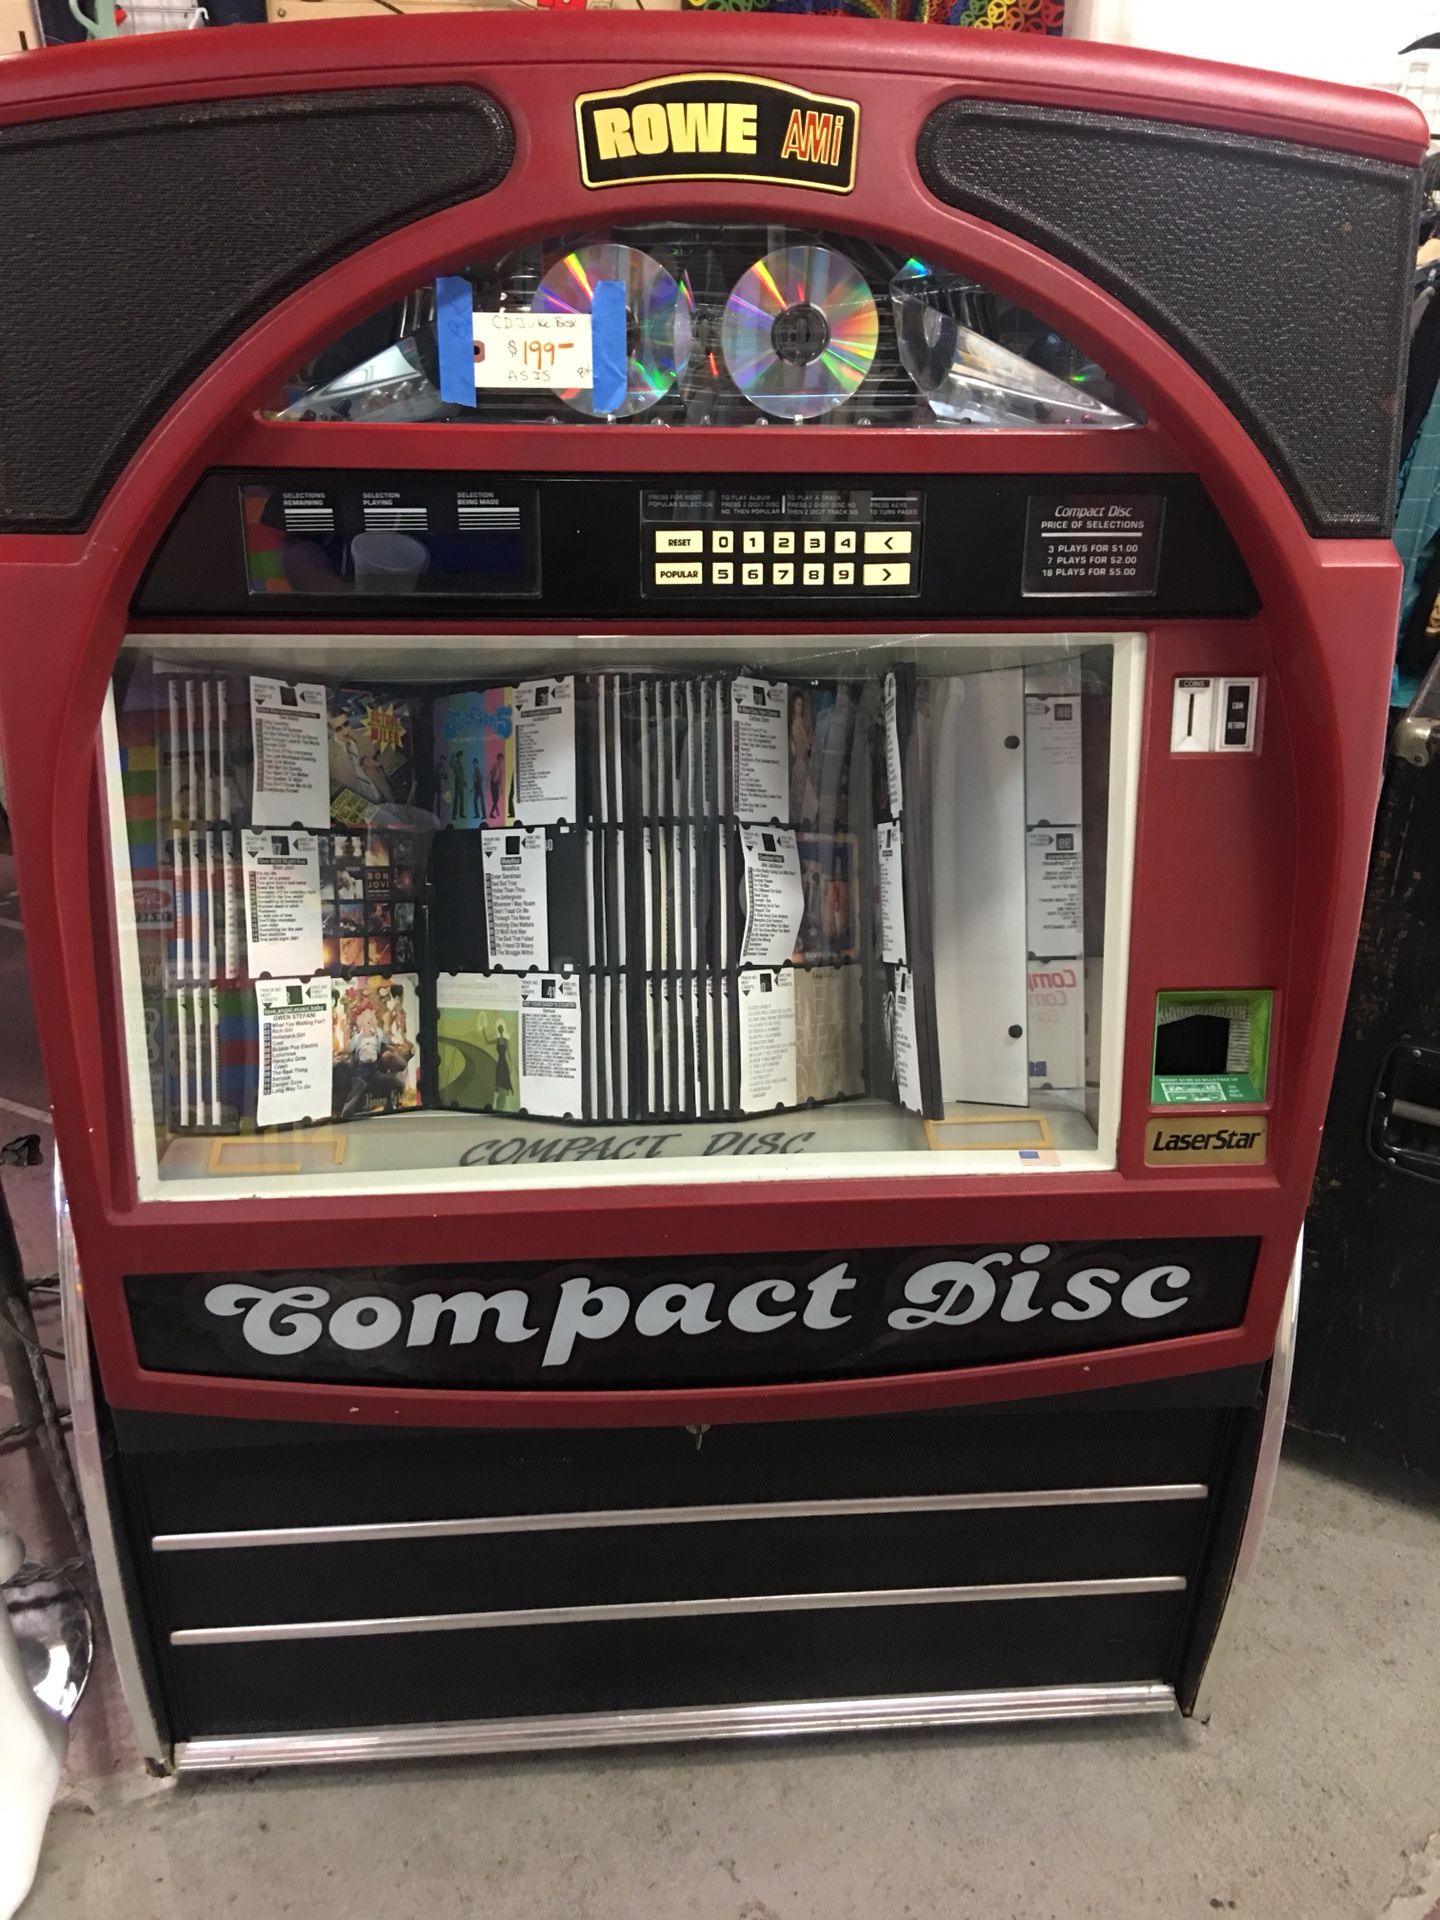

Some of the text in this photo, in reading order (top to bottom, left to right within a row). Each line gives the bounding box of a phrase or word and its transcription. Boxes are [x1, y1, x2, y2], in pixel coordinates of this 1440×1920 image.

[593, 103, 757, 160] ROWE
[493, 316, 512, 328] CD
[1055, 505, 1132, 518] Compact Disc
[668, 539, 691, 547] RESET
[719, 537, 728, 548] 0
[750, 538, 755, 547] 1
[779, 538, 789, 547] 2
[810, 538, 820, 548] 3
[841, 538, 850, 547] 4
[1111, 556, 1137, 564] $2.00
[660, 570, 698, 578] POPULAR
[718, 570, 728, 579] 5
[748, 570, 758, 579] 6
[778, 570, 789, 579] 7
[809, 570, 819, 580] 8
[839, 570, 849, 579] 9
[368, 872, 389, 880] BON
[1153, 1129, 1261, 1151] LaserStar
[459, 1131, 815, 1167] COMPACT DISC
[204, 1244, 1194, 1367] Compact Disc
